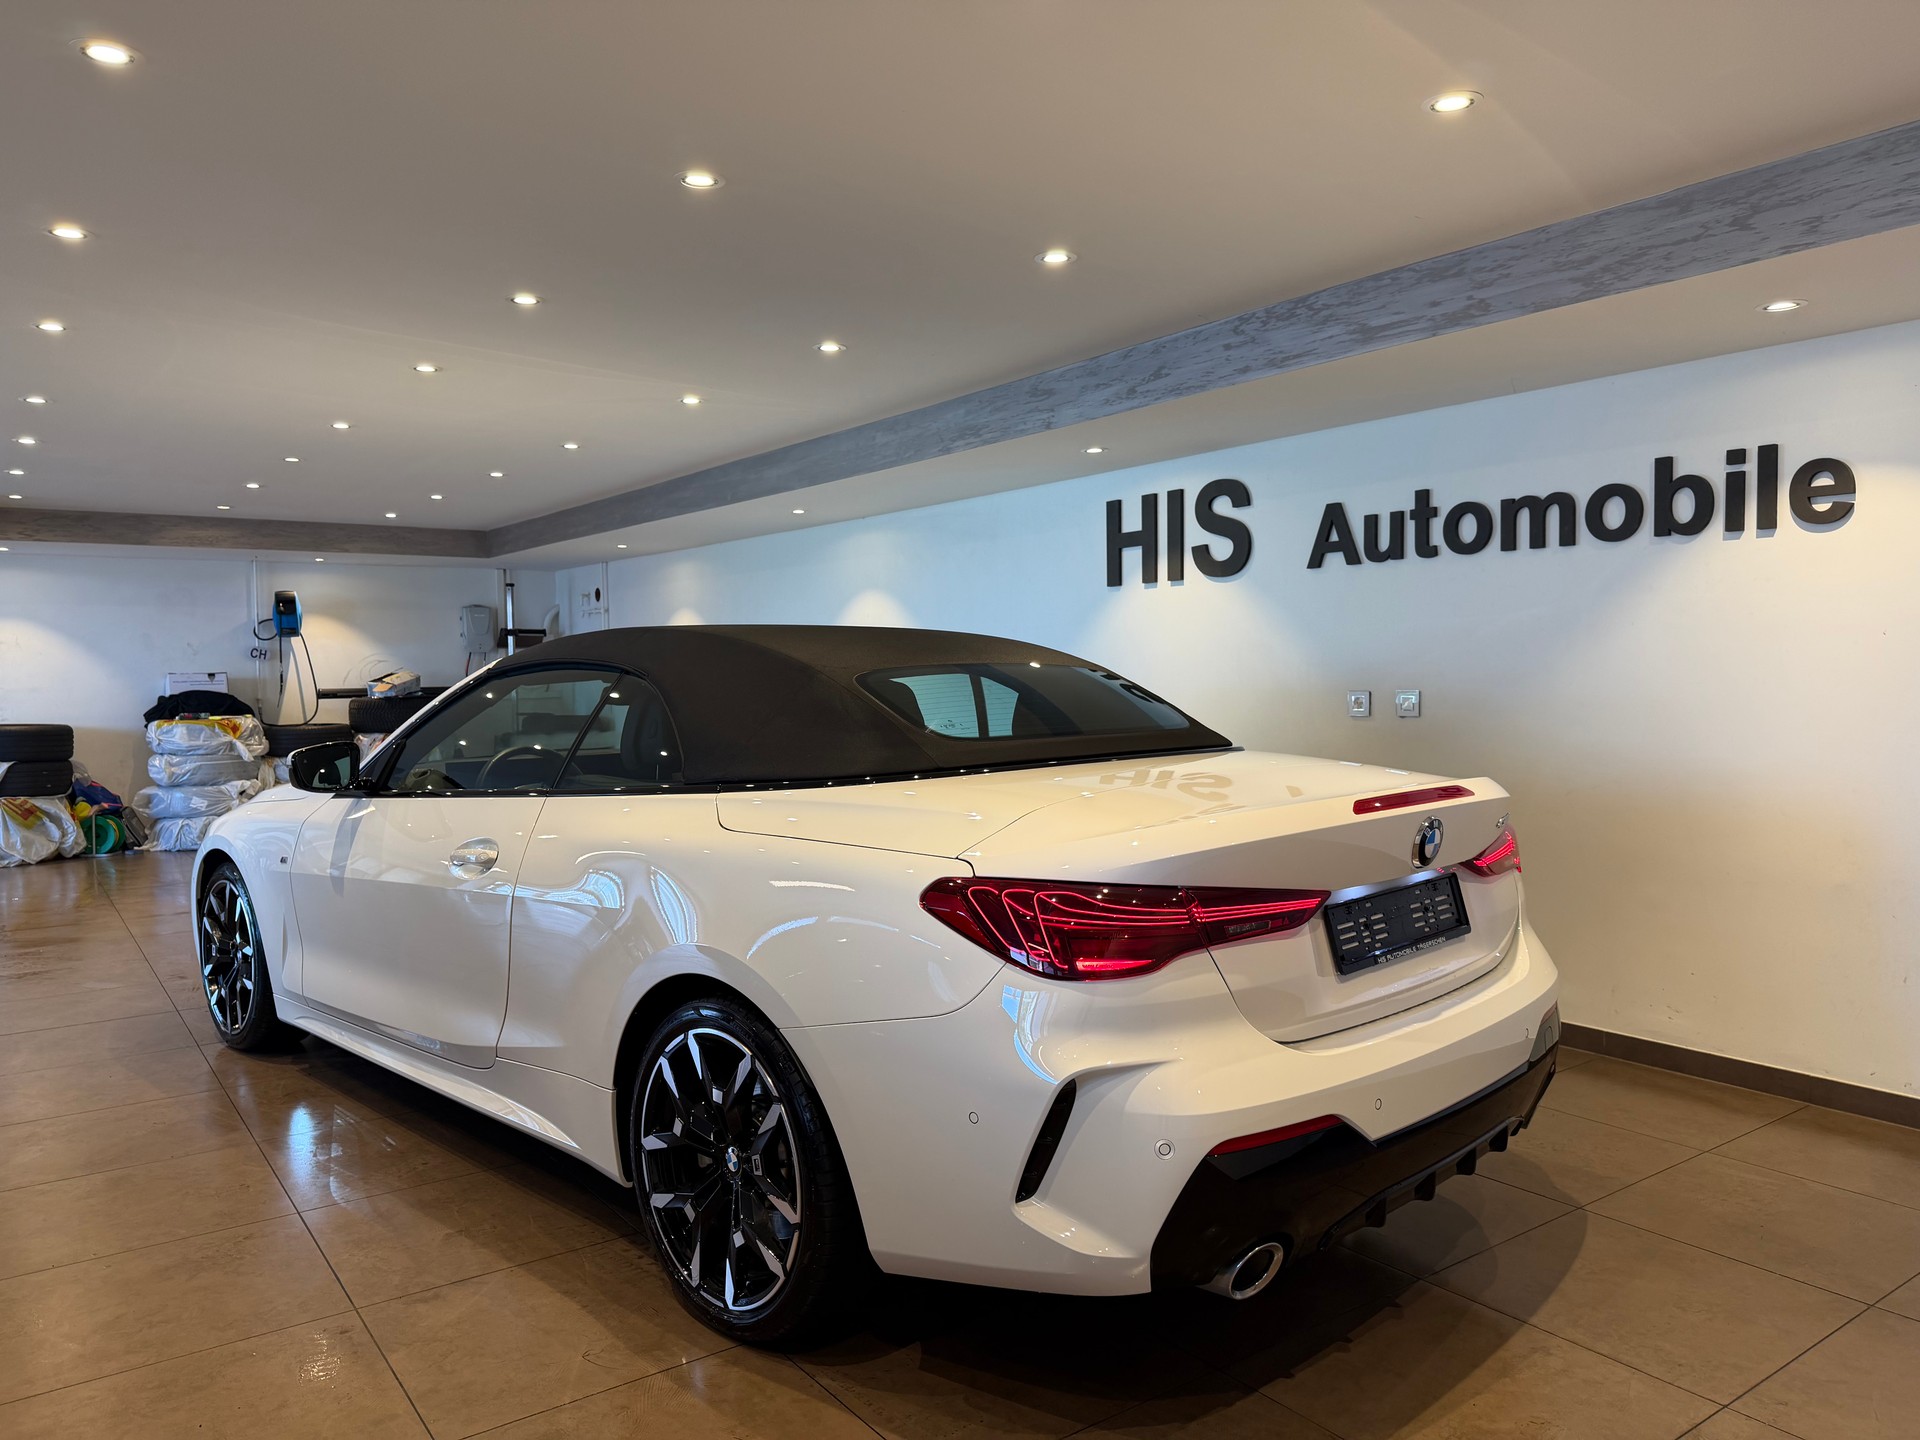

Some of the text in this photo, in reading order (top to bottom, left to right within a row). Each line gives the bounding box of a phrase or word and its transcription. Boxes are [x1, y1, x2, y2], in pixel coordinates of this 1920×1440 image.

[1106, 444, 1857, 587] HIS Automobile
[250, 647, 268, 660] CH
[1377, 956, 1386, 964] HIS
[1386, 946, 1416, 961] AUTOMOBILE
